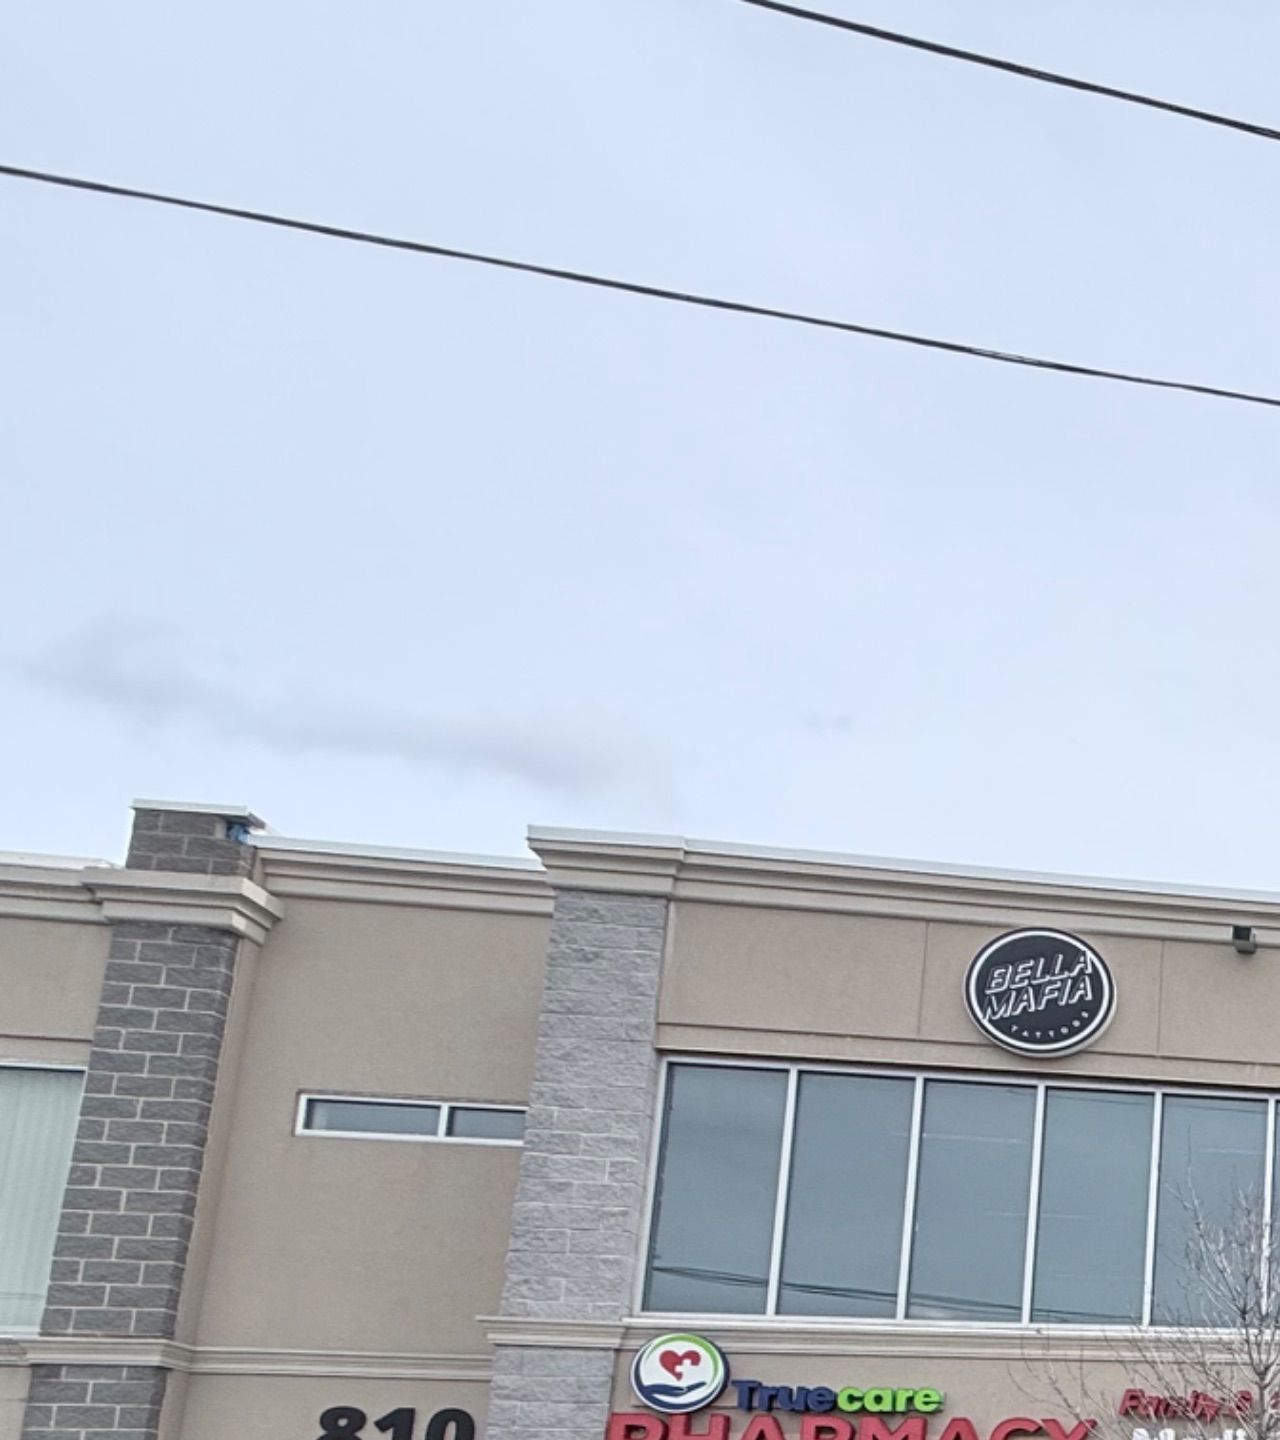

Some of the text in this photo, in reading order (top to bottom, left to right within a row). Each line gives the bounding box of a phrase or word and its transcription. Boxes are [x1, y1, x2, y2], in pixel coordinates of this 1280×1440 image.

[985, 950, 1093, 995] BELLA
[983, 975, 1093, 1021] MAFIA
[729, 1379, 947, 1414] Truecare
